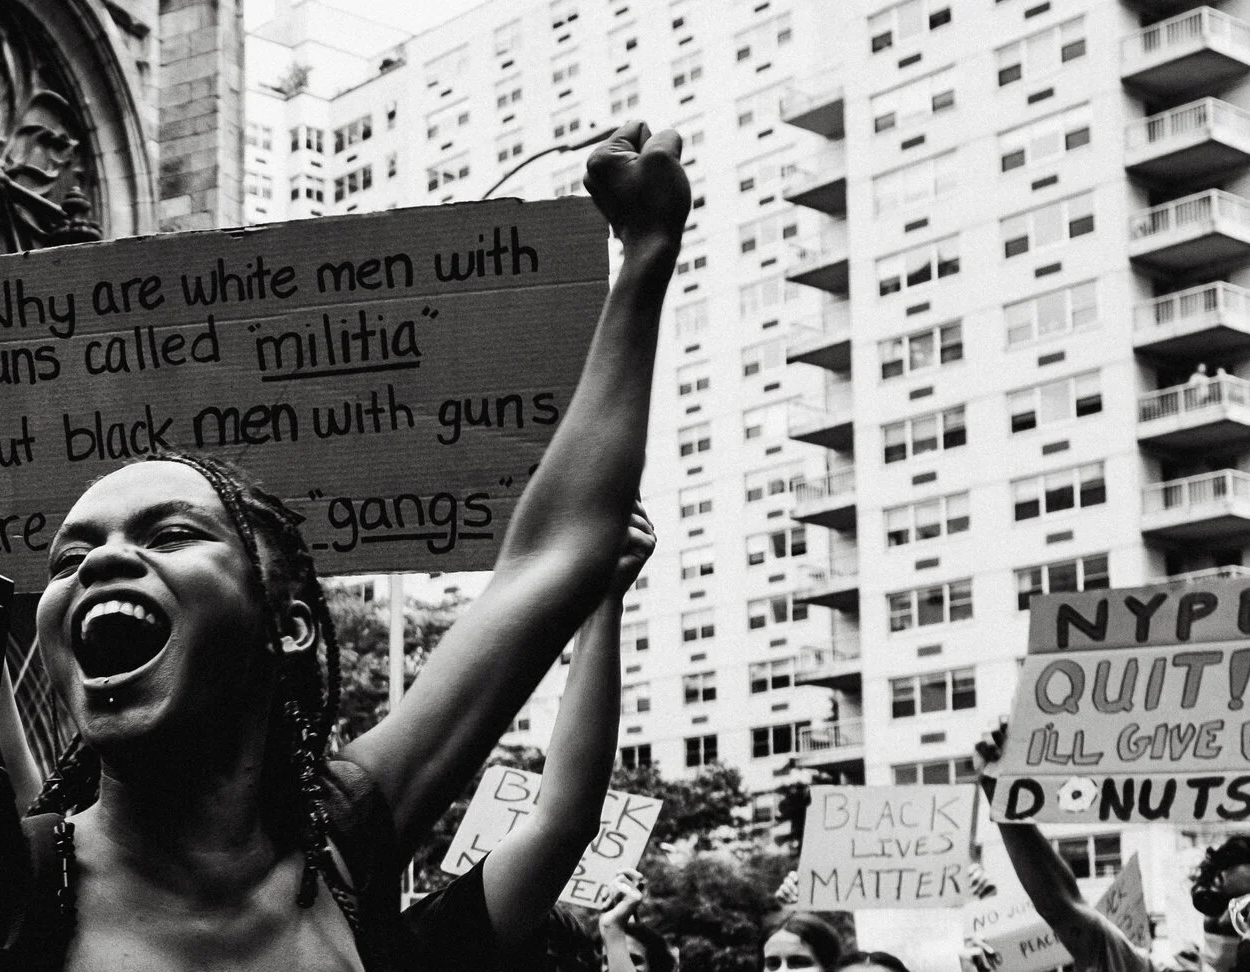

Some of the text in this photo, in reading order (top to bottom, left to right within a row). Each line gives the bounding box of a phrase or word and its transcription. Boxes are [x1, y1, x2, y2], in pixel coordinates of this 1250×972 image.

[91, 271, 166, 316] are
[181, 258, 299, 307] white
[316, 253, 415, 297] men
[434, 227, 539, 283] with
[84, 314, 221, 377] called
[63, 405, 175, 462] black
[193, 403, 299, 448] men
[312, 384, 415, 439] with
[437, 388, 560, 445] guns
[1034, 648, 1250, 716] QUIT!
[1115, 719, 1226, 762] GIVE
[822, 792, 961, 832] BLACK
[851, 832, 955, 860] LIVES
[809, 864, 962, 905] MATTER
[972, 910, 1000, 932] NO
